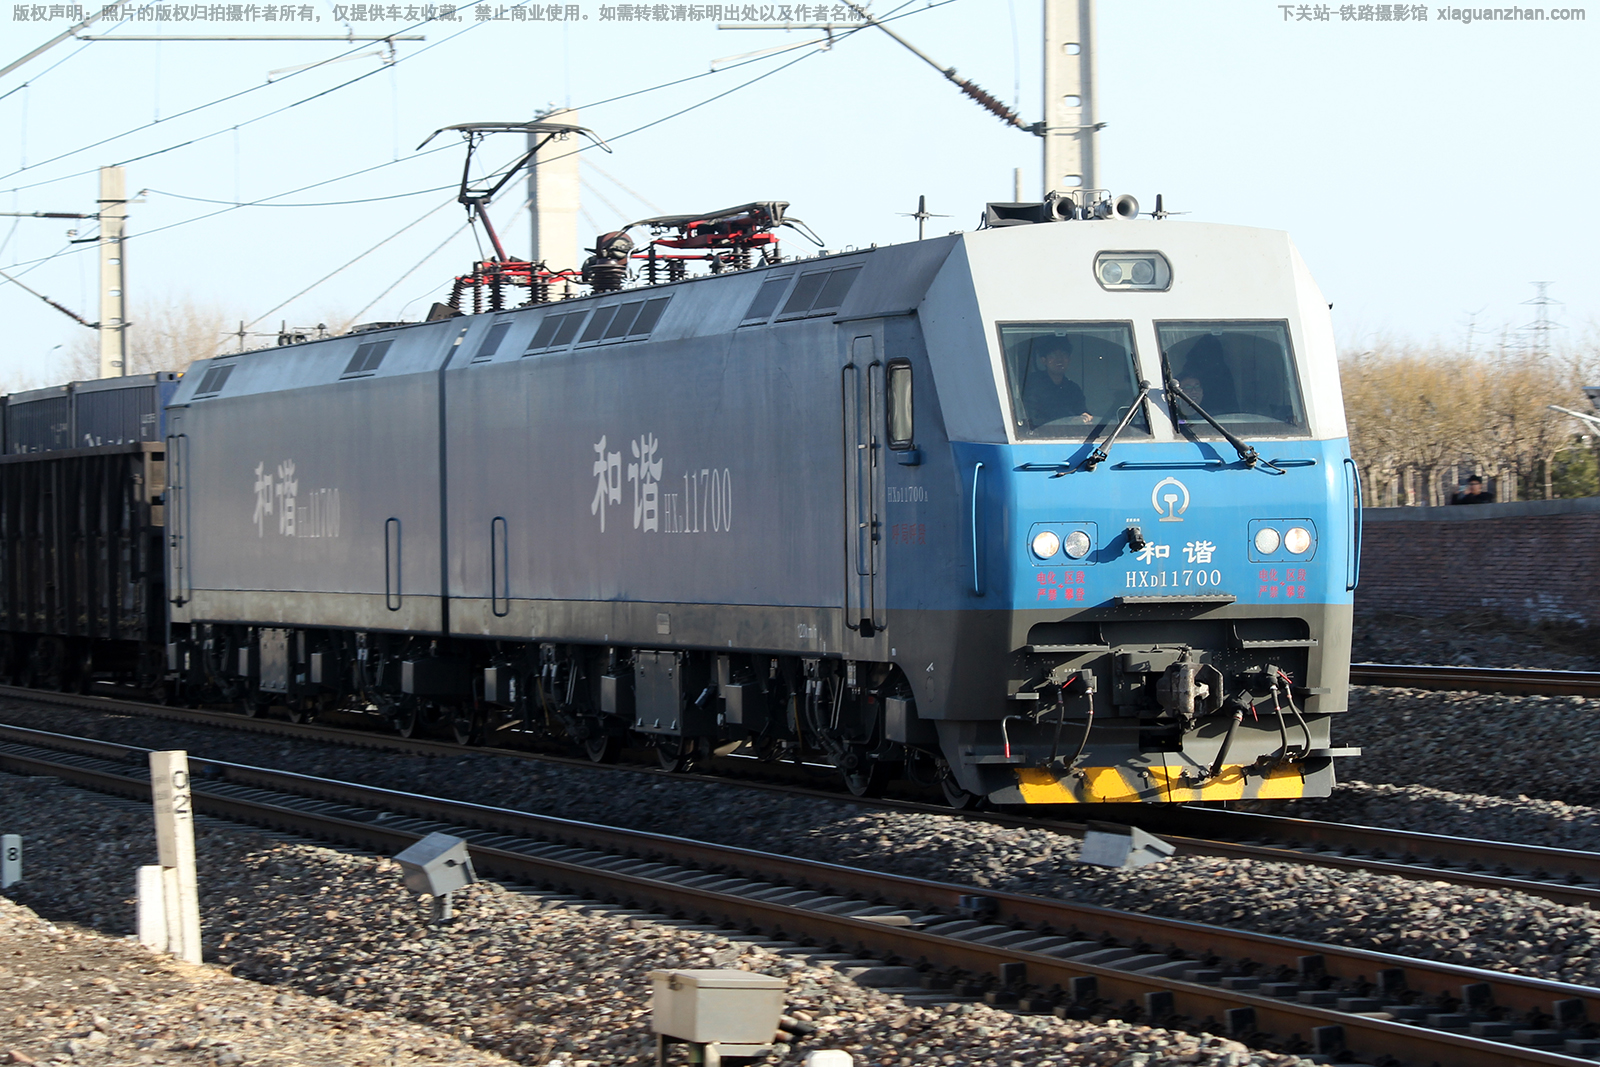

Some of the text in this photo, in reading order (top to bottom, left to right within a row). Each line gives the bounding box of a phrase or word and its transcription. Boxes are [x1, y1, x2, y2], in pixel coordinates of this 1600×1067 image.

[253, 459, 298, 538] 和谐
[591, 432, 663, 533] 和谐
[1126, 569, 1222, 588] HXD11700
[1136, 540, 1217, 565] 和谐
